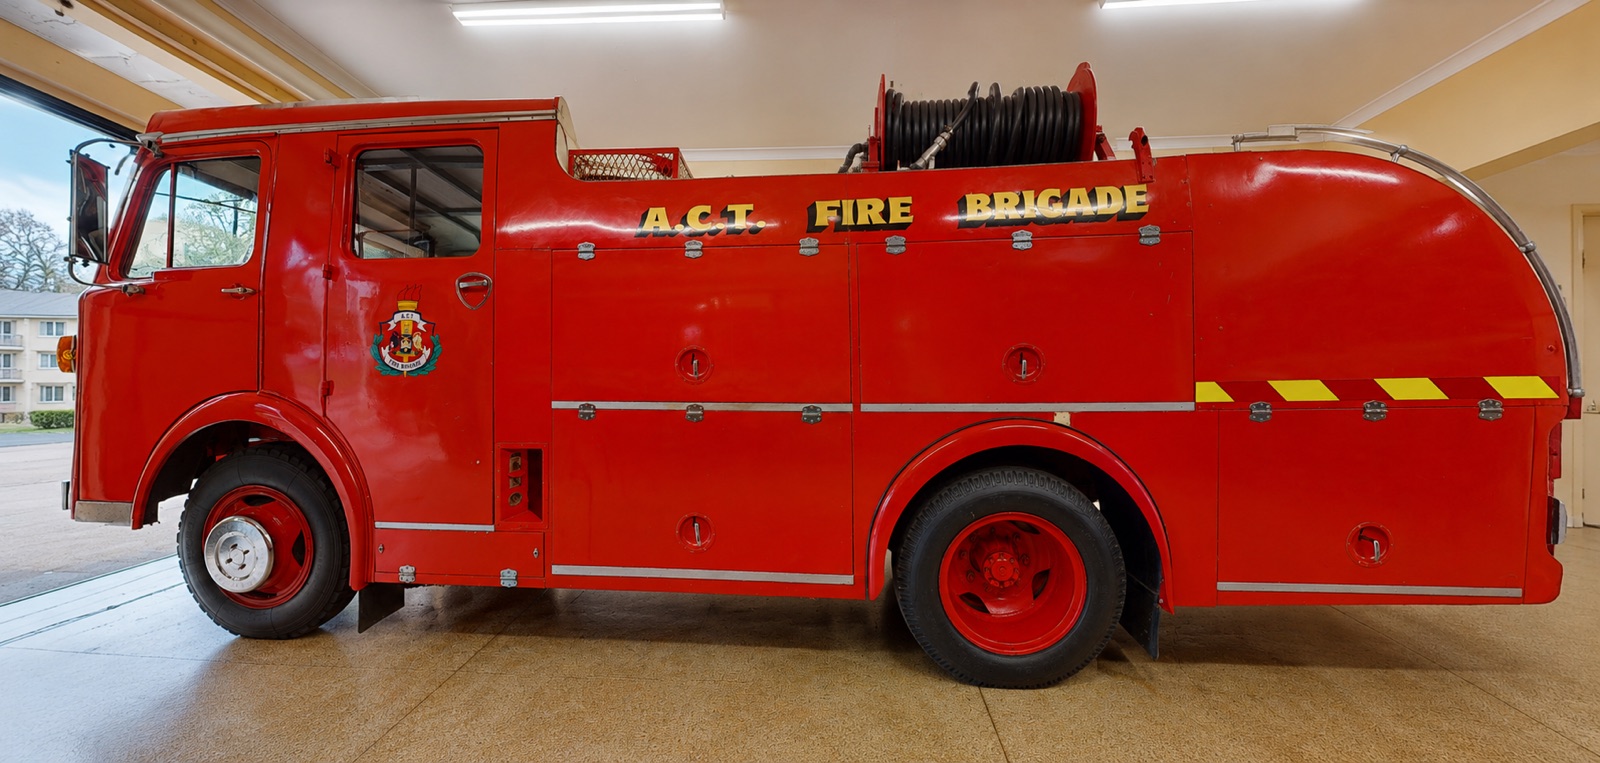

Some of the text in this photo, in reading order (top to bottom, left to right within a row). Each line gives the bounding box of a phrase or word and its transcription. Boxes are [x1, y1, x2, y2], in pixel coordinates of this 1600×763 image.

[636, 184, 1149, 236] A.C.T. FIRE BRIGADE
